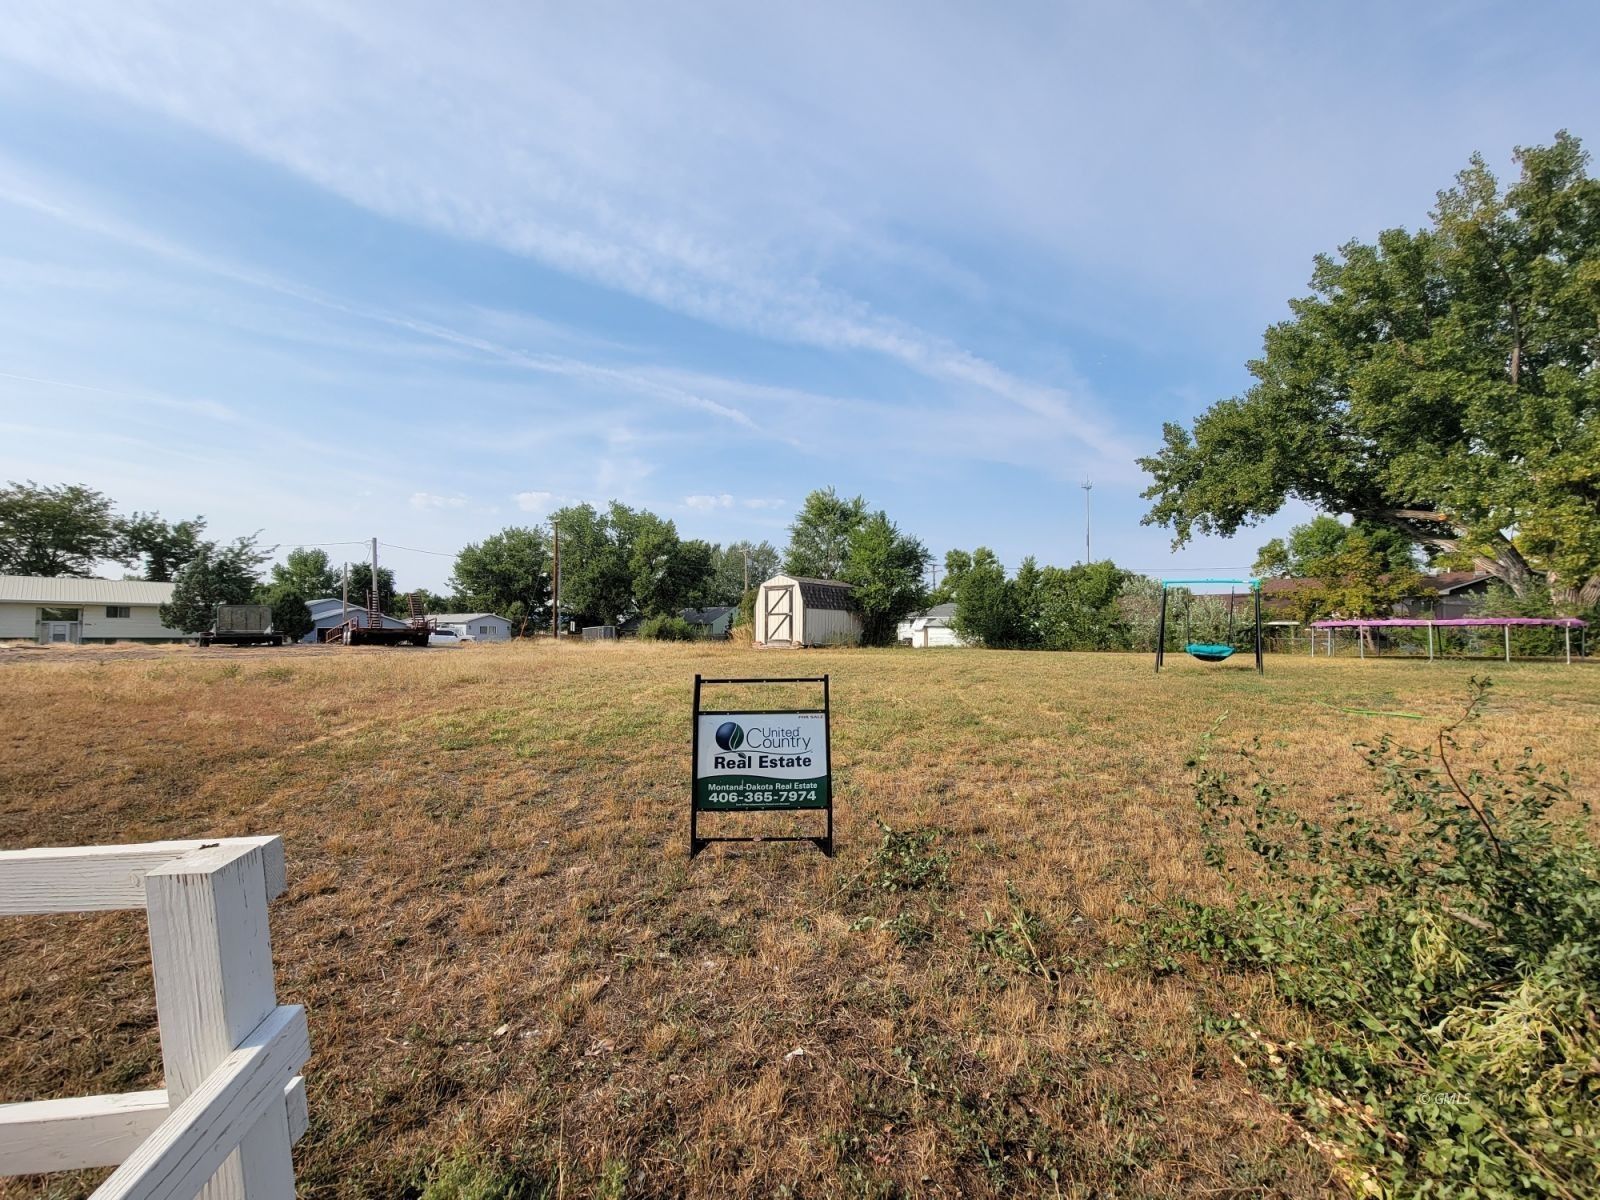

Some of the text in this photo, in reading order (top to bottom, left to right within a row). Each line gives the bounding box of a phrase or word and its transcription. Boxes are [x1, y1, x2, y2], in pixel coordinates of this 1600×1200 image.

[746, 727, 811, 750] Country
[762, 727, 800, 738] United
[714, 755, 812, 769] Real Estate
[708, 783, 773, 791] Montana-Dakota
[775, 782, 792, 790] Real
[708, 791, 817, 803] 406-365-7974
